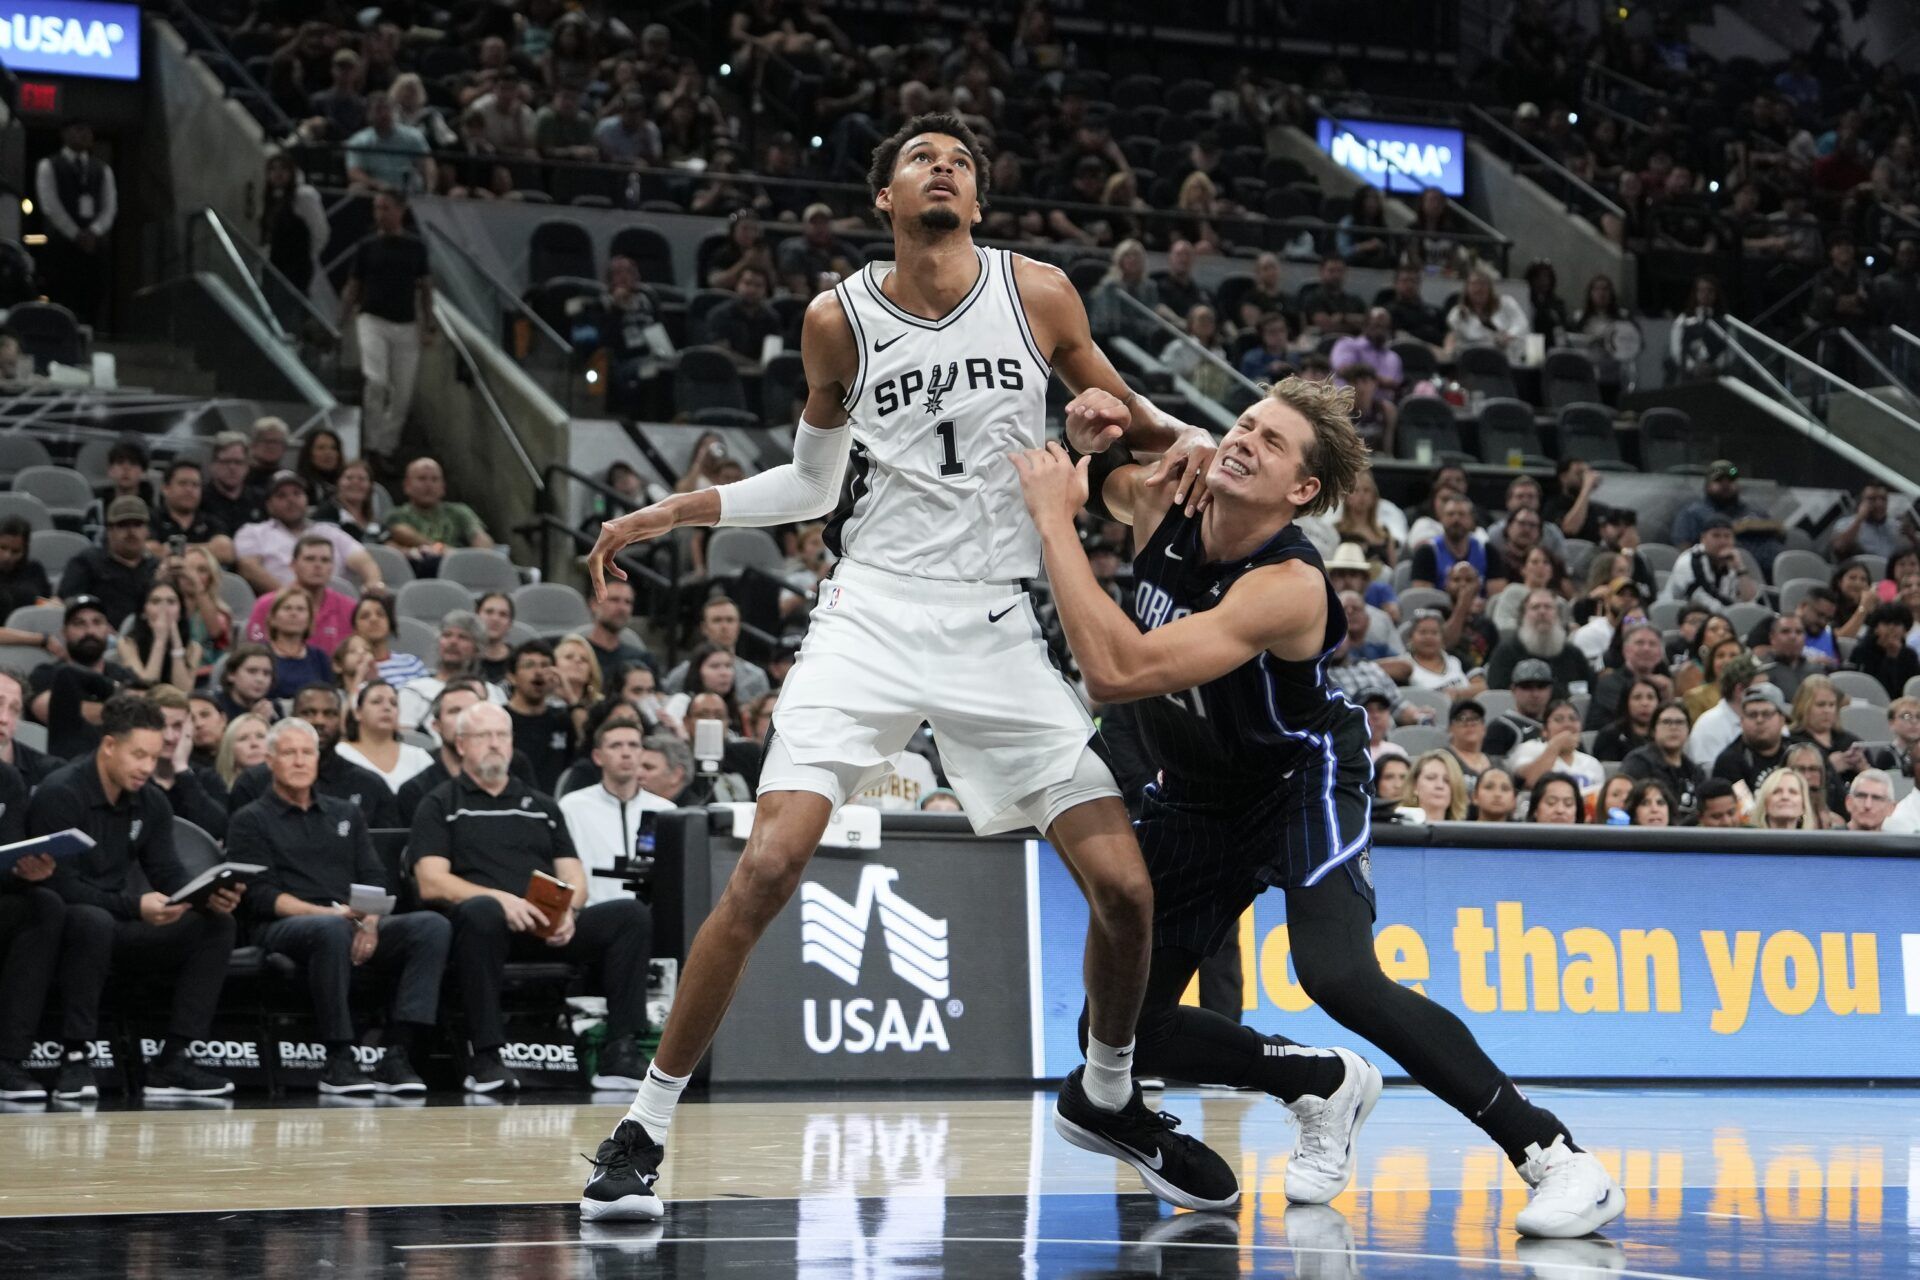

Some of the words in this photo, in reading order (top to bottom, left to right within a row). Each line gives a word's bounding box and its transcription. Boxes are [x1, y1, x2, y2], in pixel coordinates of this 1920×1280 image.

[874, 357, 1024, 418] SPURS
[934, 418, 967, 480] 1
[1453, 901, 1682, 1013] than
[1700, 929, 1882, 1035] you
